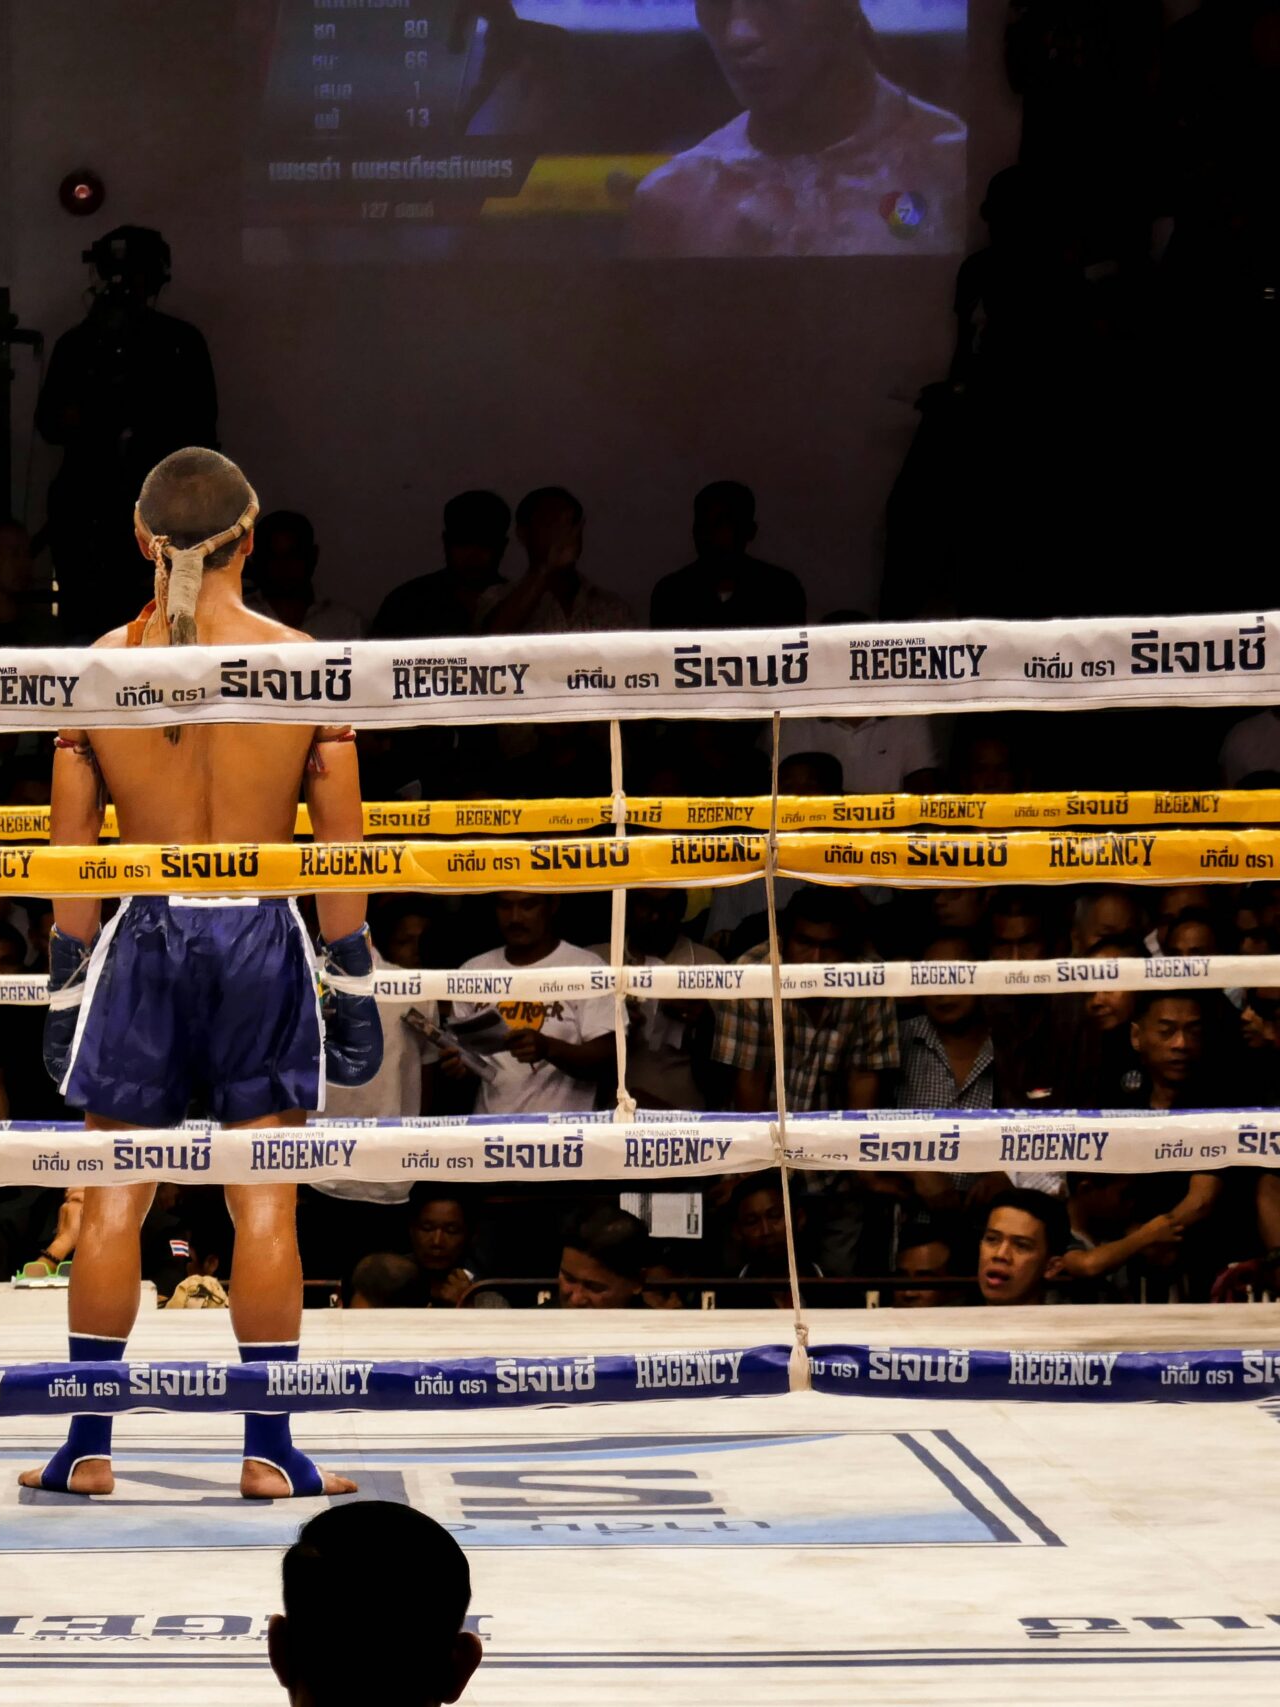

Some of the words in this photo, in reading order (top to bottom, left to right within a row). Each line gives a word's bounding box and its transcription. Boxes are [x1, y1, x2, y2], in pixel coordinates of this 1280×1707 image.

[404, 20, 428, 39] 80
[404, 51, 428, 70] 66
[413, 80, 422, 99] 1
[405, 107, 431, 128] 13
[361, 202, 388, 219] 127
[850, 639, 870, 648] BRAND
[873, 638, 903, 647] DRINKING
[905, 638, 926, 646] WATER
[1024, 653, 1074, 681] น้ำดื่ม
[1081, 660, 1116, 679] ตรา
[1131, 617, 1266, 676] รีเจนซี่
[393, 658, 414, 667] BRAND
[415, 658, 445, 667] DRINKING
[447, 658, 467, 666] WATER
[566, 667, 617, 691] น้ำดื่ม
[624, 672, 660, 690] ตรา
[673, 632, 809, 690] รีเจนซี่
[849, 645, 988, 681] REGENCY
[115, 682, 164, 707] น้ำดื่ม
[172, 687, 206, 703] ตรา
[220, 647, 353, 703] รีเจนซี่
[393, 664, 530, 700] REGENCY
[369, 804, 432, 828] รีเจนซี่
[687, 805, 754, 824] REGENCY
[833, 796, 896, 822] รีเจนซี่
[919, 799, 987, 820] REGENCY
[1066, 793, 1129, 816] รีเจนซี่
[1153, 795, 1220, 816] REGENCY
[455, 809, 522, 827] REGENCY
[299, 845, 407, 878] REGENCY
[447, 849, 486, 872] น้ำดื่ม
[493, 855, 521, 871] ตรา
[824, 842, 863, 865] น้ำดื่ม
[870, 849, 897, 865] ตรา
[1047, 834, 1156, 868] REGENCY
[1200, 846, 1240, 868] น้ำดื่ม
[1245, 852, 1274, 868] ตรา
[79, 857, 117, 880] น้ำดื่ม
[124, 863, 151, 879] ตรา
[823, 966, 885, 988] รีเจนซี่
[910, 966, 979, 986] REGENCY
[1057, 960, 1120, 983] รีเจนซี่
[1144, 958, 1211, 978] REGENCY
[447, 975, 514, 997] REGENCY
[677, 970, 745, 991] REGENCY
[32, 1151, 71, 1171] น้ำดื่ม
[77, 1156, 104, 1171] ตรา
[113, 1131, 212, 1171] รีเจนซี่
[402, 1149, 440, 1171] น้ำดื่ม
[446, 1154, 474, 1170] ตรา
[483, 1128, 584, 1168] รีเจนซี่
[624, 1138, 734, 1168] REGENCY
[859, 1124, 960, 1162] รีเจนซี่
[1000, 1132, 1109, 1163] REGENCY
[1156, 1138, 1193, 1160] น้ำดื่ม
[1200, 1145, 1227, 1158] ตรา
[251, 1140, 357, 1171] REGENCY
[266, 1363, 374, 1397] REGENCY
[634, 1352, 744, 1391] REGENCY
[831, 1362, 859, 1379] ตรา
[1008, 1353, 1119, 1386] REGENCY
[1160, 1364, 1199, 1385] น้ำดื่ม
[1206, 1370, 1234, 1385] ตรา
[48, 1377, 86, 1397] น้ำดื่ม
[93, 1381, 121, 1397] ตรา
[415, 1371, 454, 1396] น้ำดื่ม
[459, 1379, 487, 1395] ตรา
